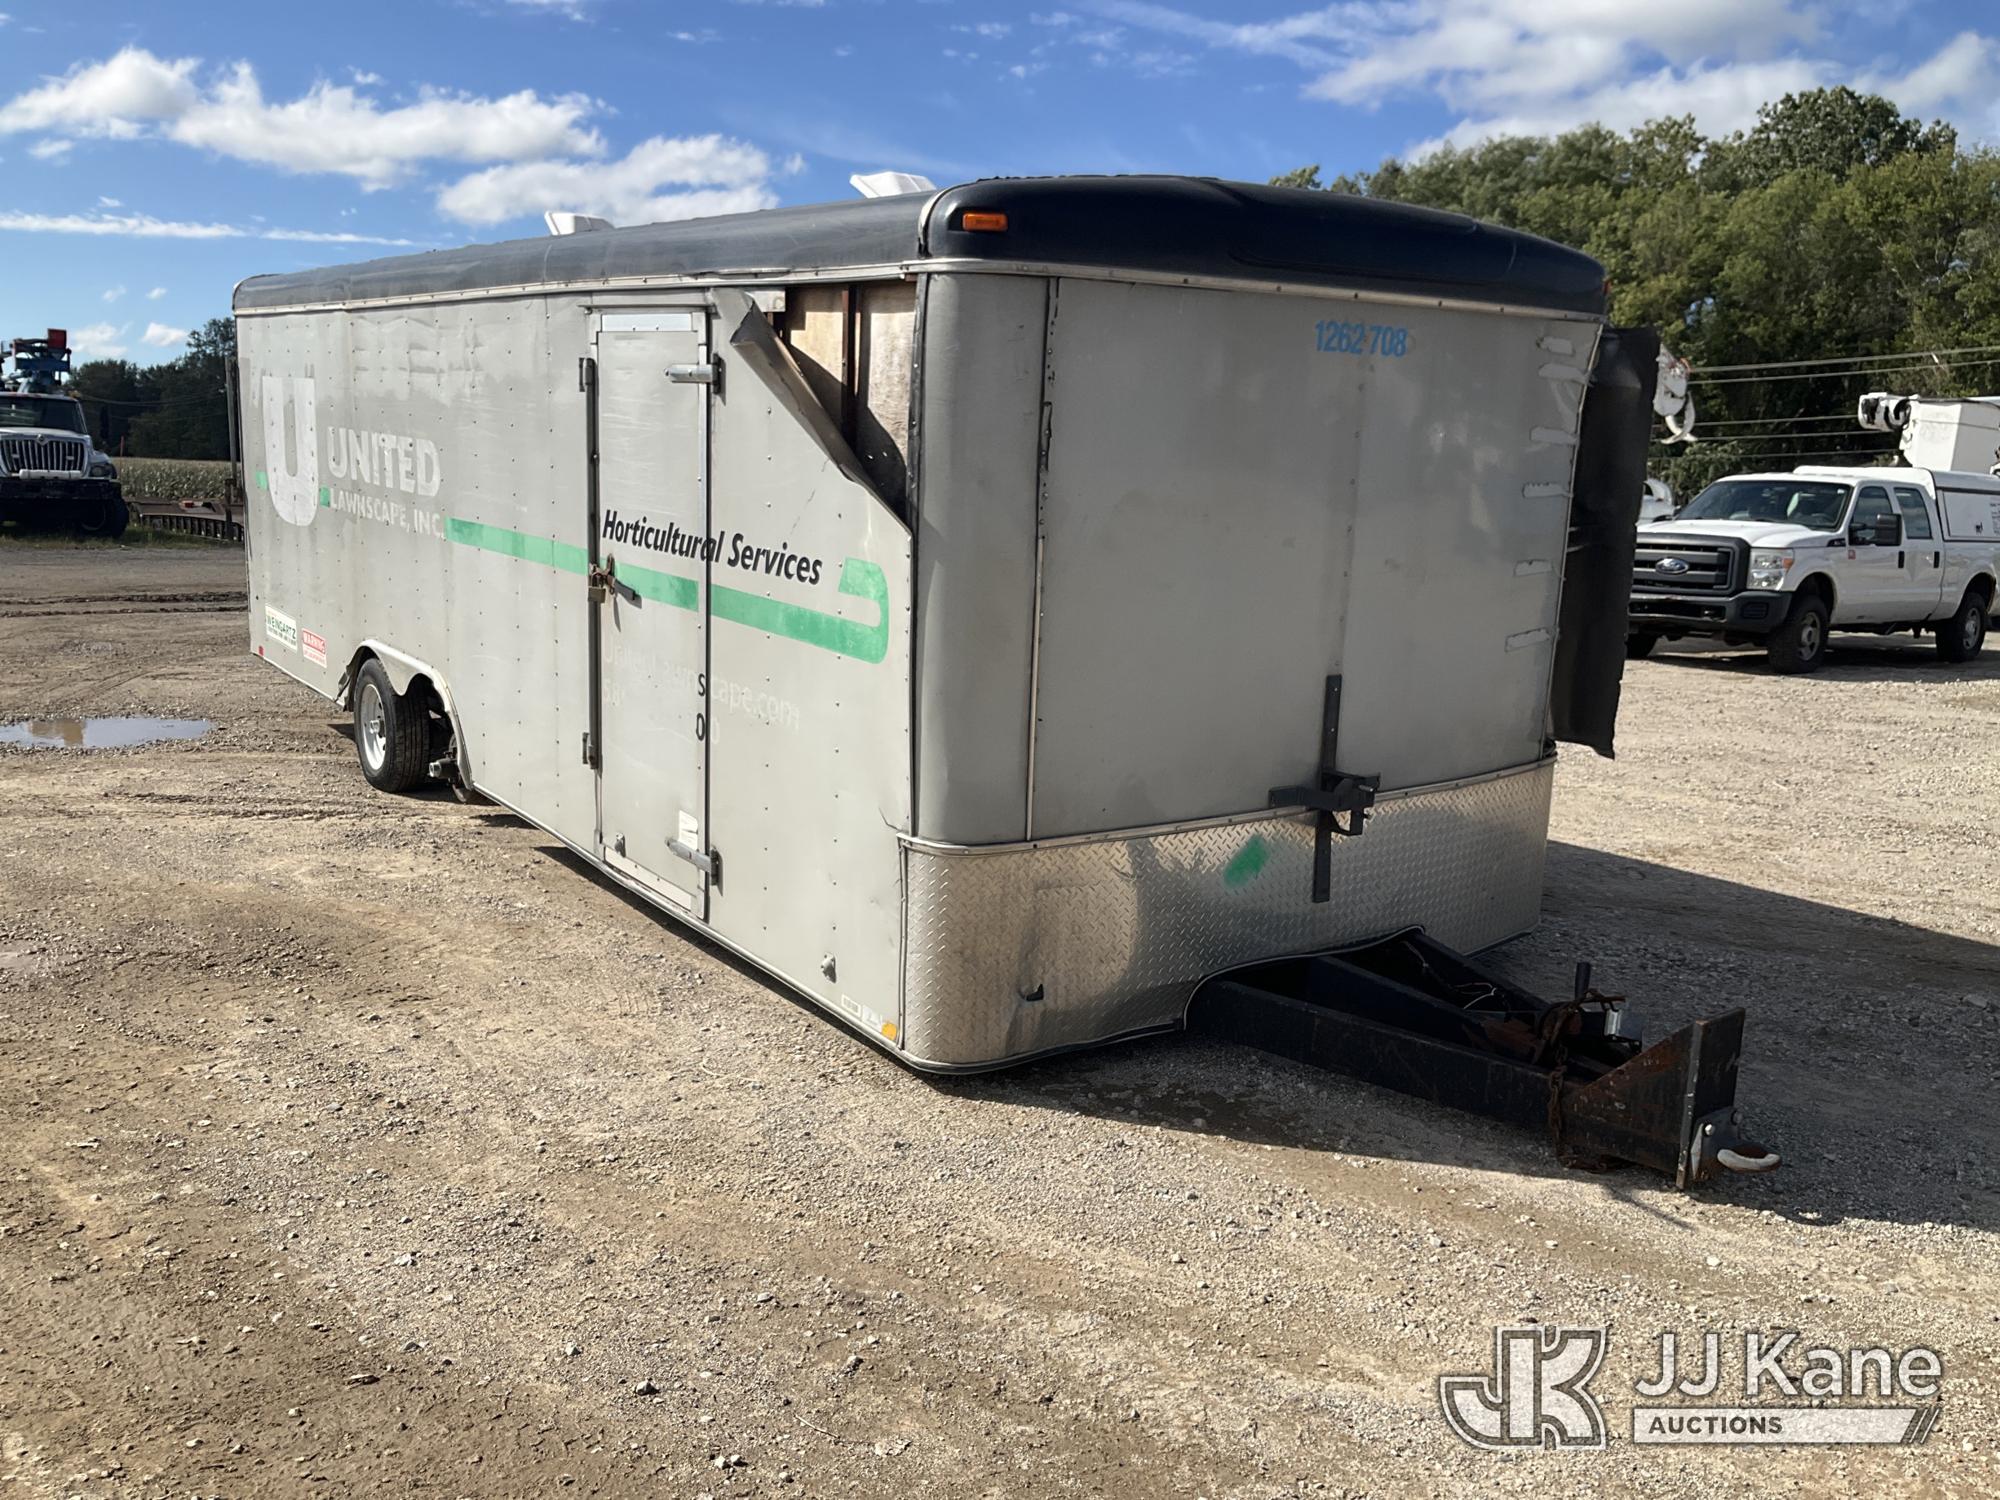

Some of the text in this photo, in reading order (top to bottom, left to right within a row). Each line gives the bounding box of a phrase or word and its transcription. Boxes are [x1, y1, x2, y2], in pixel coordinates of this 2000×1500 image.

[261, 376, 319, 526] U
[327, 426, 441, 497] UNITED
[602, 509, 823, 586] Horticultural Services
